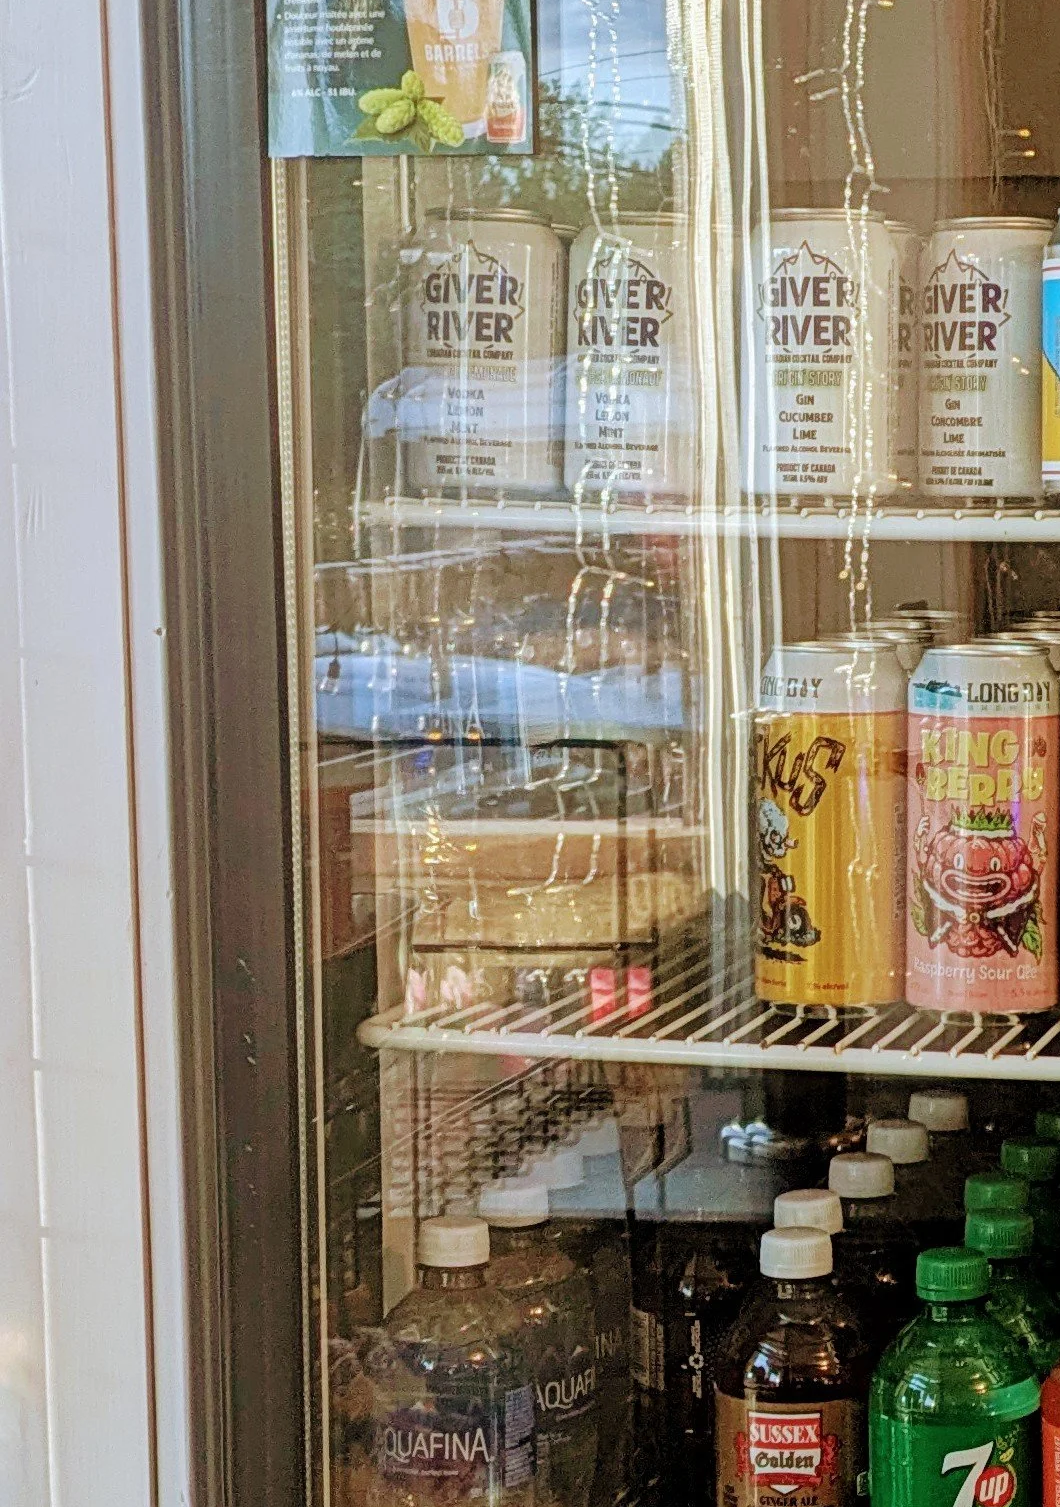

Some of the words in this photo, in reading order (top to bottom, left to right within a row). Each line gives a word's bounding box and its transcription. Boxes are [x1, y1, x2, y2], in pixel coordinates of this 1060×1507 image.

[427, 311, 513, 343] RIVER
[766, 315, 851, 346] RIVER
[923, 321, 997, 351] RIVER
[967, 683, 1018, 703] LONG
[921, 727, 1019, 768] KING
[926, 766, 1044, 807] BERRY
[979, 964, 1013, 981] Sour
[749, 1423, 818, 1444] SUSSEX
[755, 1451, 814, 1469] Golden
